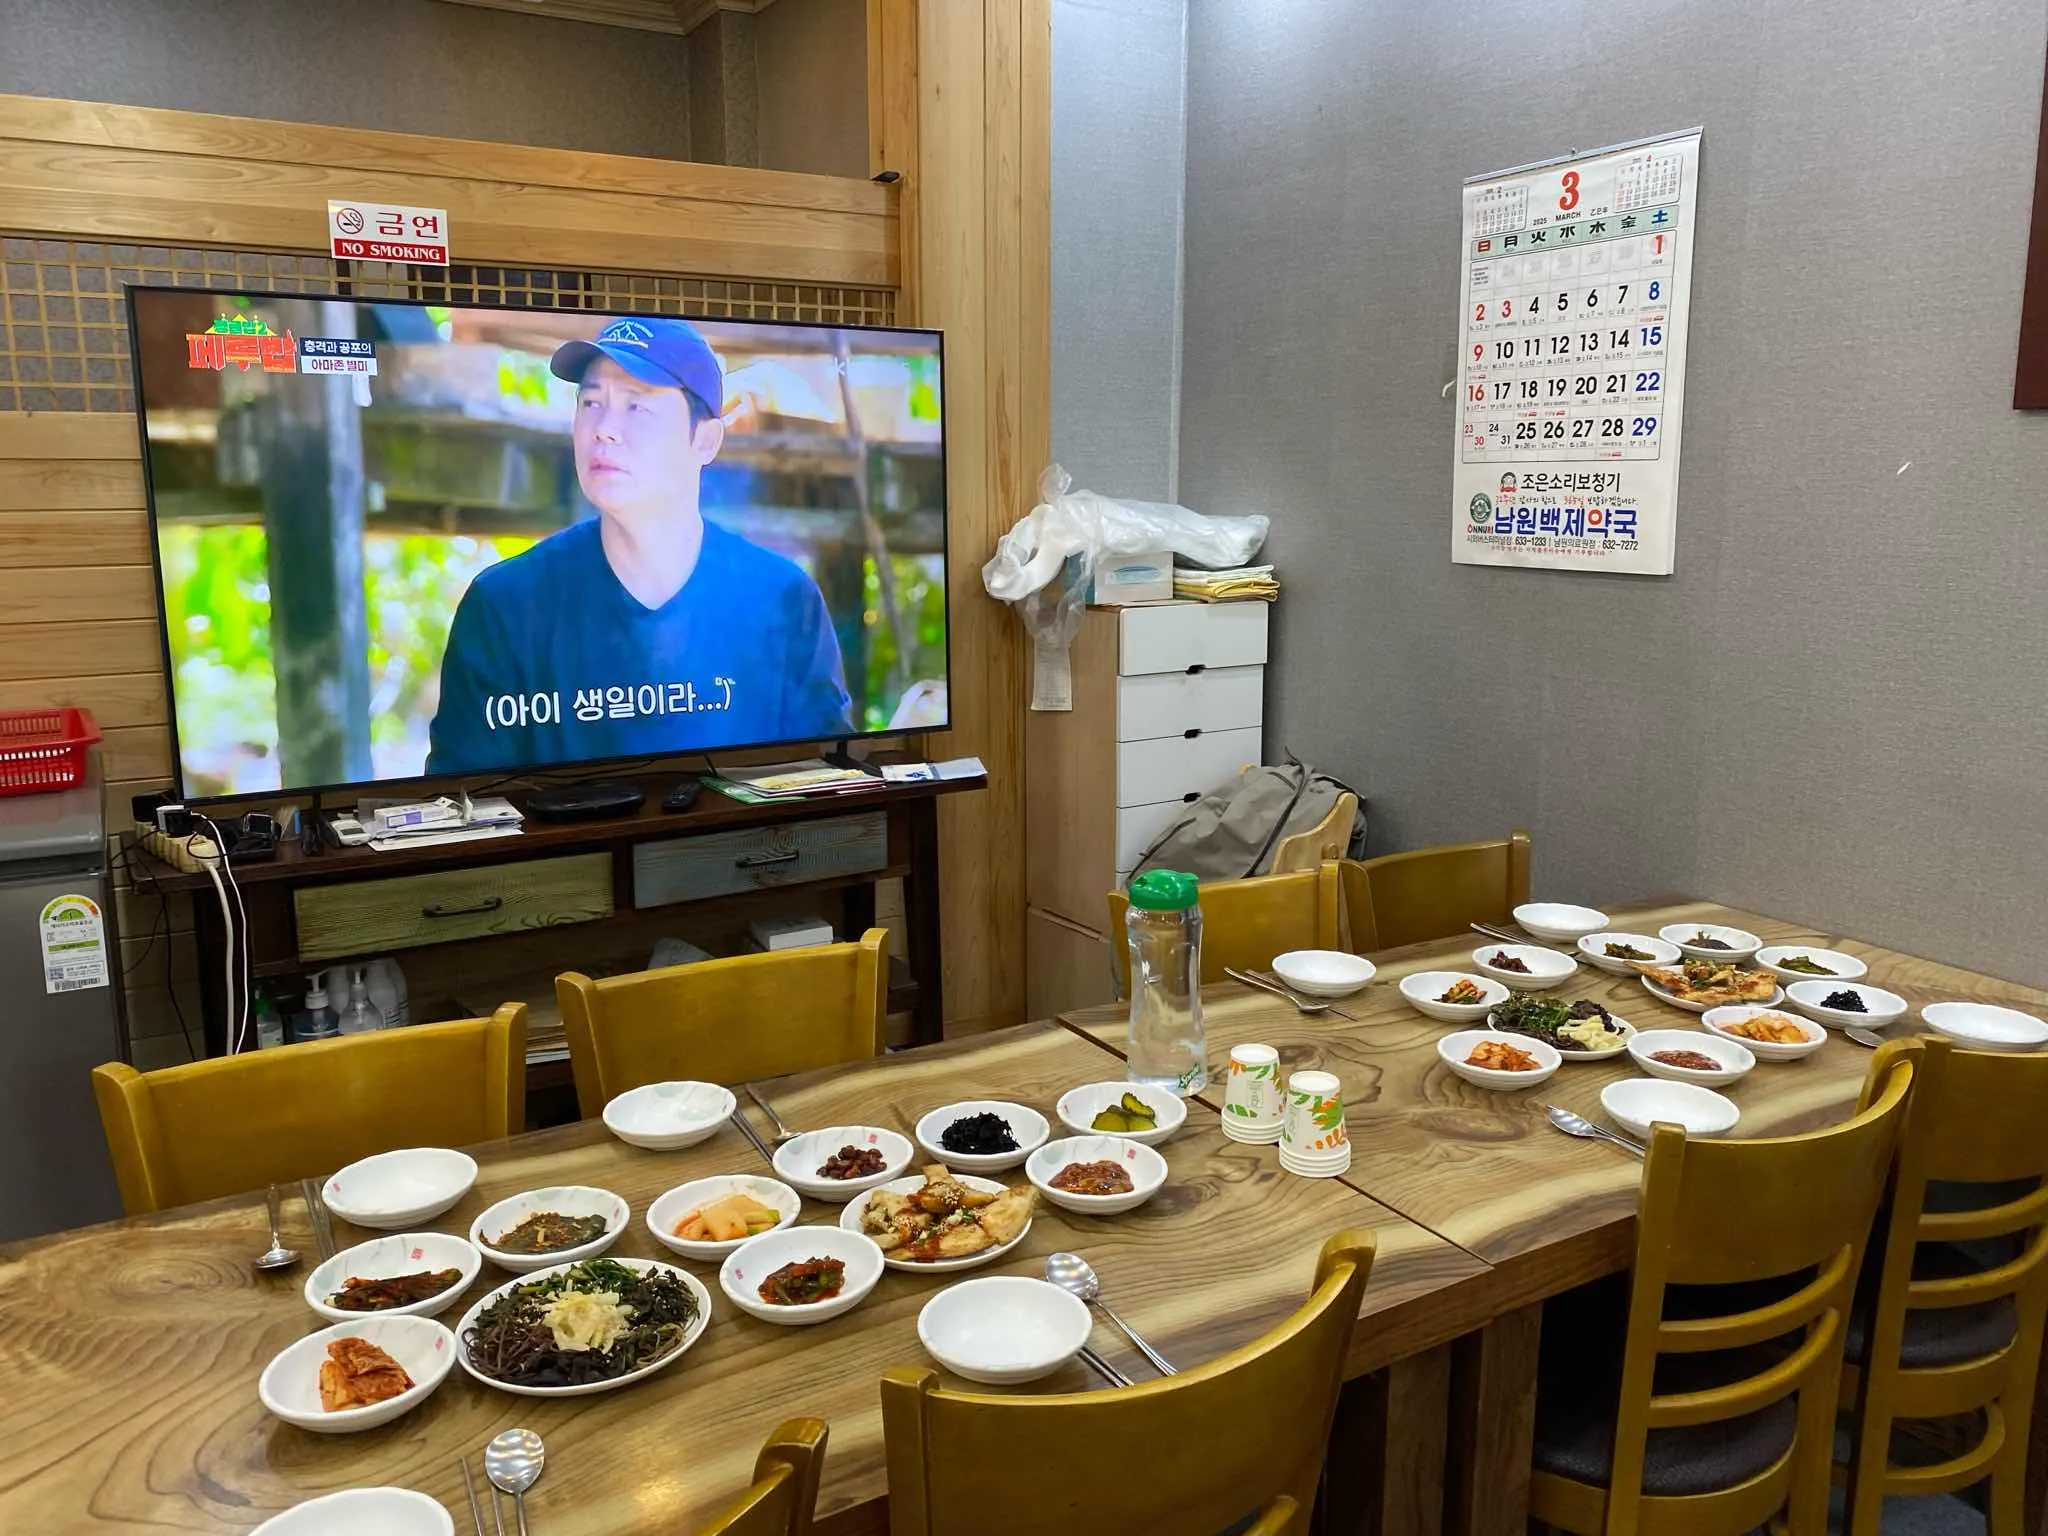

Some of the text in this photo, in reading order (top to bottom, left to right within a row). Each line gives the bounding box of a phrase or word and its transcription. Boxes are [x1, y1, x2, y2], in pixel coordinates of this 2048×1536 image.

[1559, 171, 1580, 210] 3
[376, 212, 439, 239] 금연
[1533, 217, 1548, 226] 2025
[1555, 211, 1581, 222] MARCH
[1478, 210, 1668, 252] 日 月 火 水 木 金 土
[342, 242, 440, 260] NO SMOKING
[1655, 234, 1664, 254] 1
[1476, 281, 1660, 321] 2 3 4 5 6 7 8
[304, 340, 372, 355] 충격과 공포의
[1473, 326, 1662, 361] 9 10 11 12 13 14 15
[311, 359, 368, 372] 아마존 별미
[1468, 372, 1660, 401] 16 17 18 19 20 21 22
[1464, 417, 1657, 440] 23 24 25 26 27 28 29
[1474, 435, 1510, 446] 30 31
[1521, 472, 1620, 492] 조은소리보청기
[1467, 524, 1494, 533] ONNURI
[1495, 506, 1637, 539] 남원백제약국
[1515, 536, 1547, 546] 633-1233
[1602, 539, 1639, 550] 632-7272
[485, 679, 731, 730] (아이 생일이라...)
